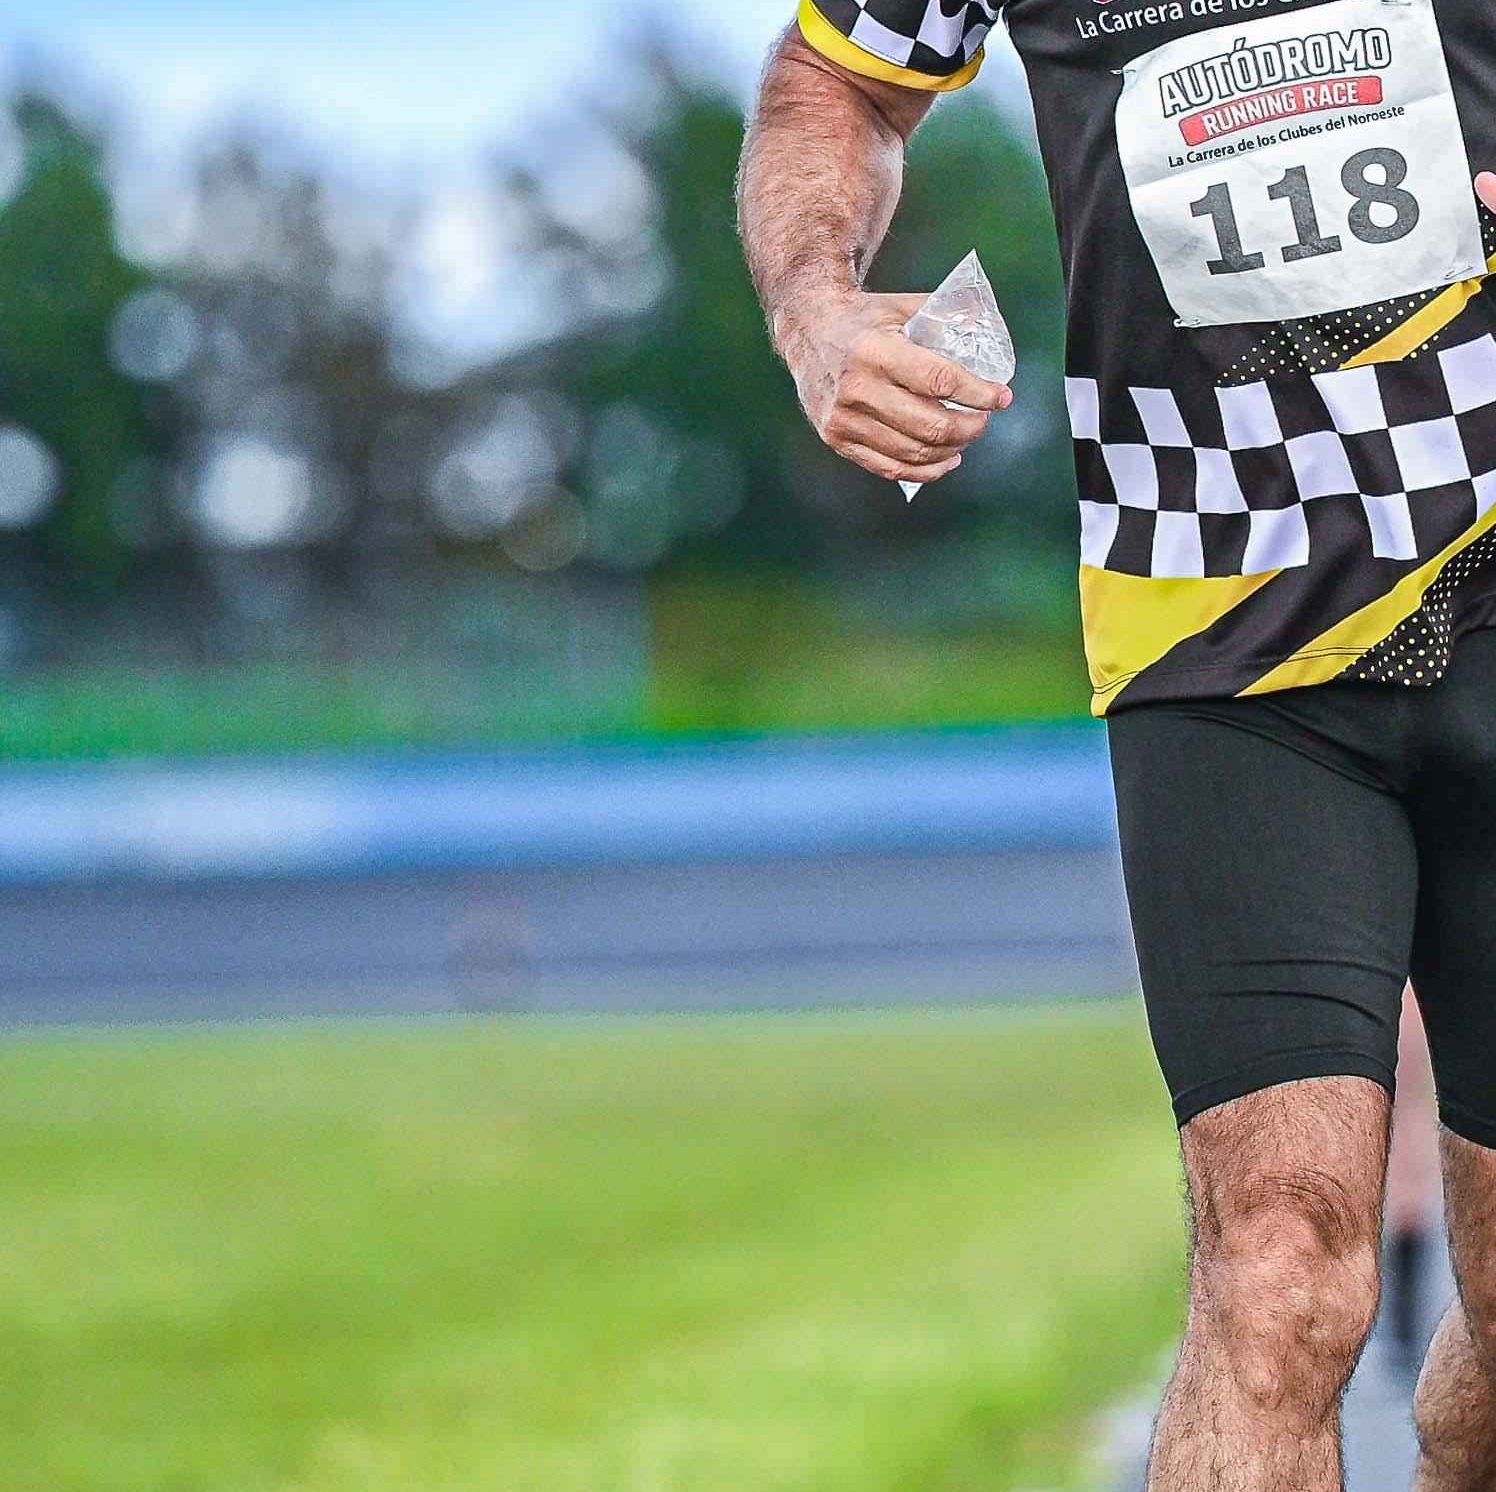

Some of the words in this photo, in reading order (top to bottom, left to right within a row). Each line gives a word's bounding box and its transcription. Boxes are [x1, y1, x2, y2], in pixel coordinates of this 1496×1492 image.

[1075, 17, 1098, 39] La
[1099, 0, 1184, 34] Carrera
[1158, 27, 1392, 118] AUTÓDROMO
[1168, 155, 1184, 168] La
[1186, 145, 1236, 165] Carrera
[1237, 136, 1255, 152] de
[1256, 133, 1277, 149] los
[1278, 123, 1323, 142] Clubes
[1325, 115, 1345, 132] del
[1348, 106, 1405, 126] Noroeste
[1201, 89, 1297, 137] RUNNING
[1302, 81, 1359, 108] RACE
[1189, 147, 1420, 276] 118
